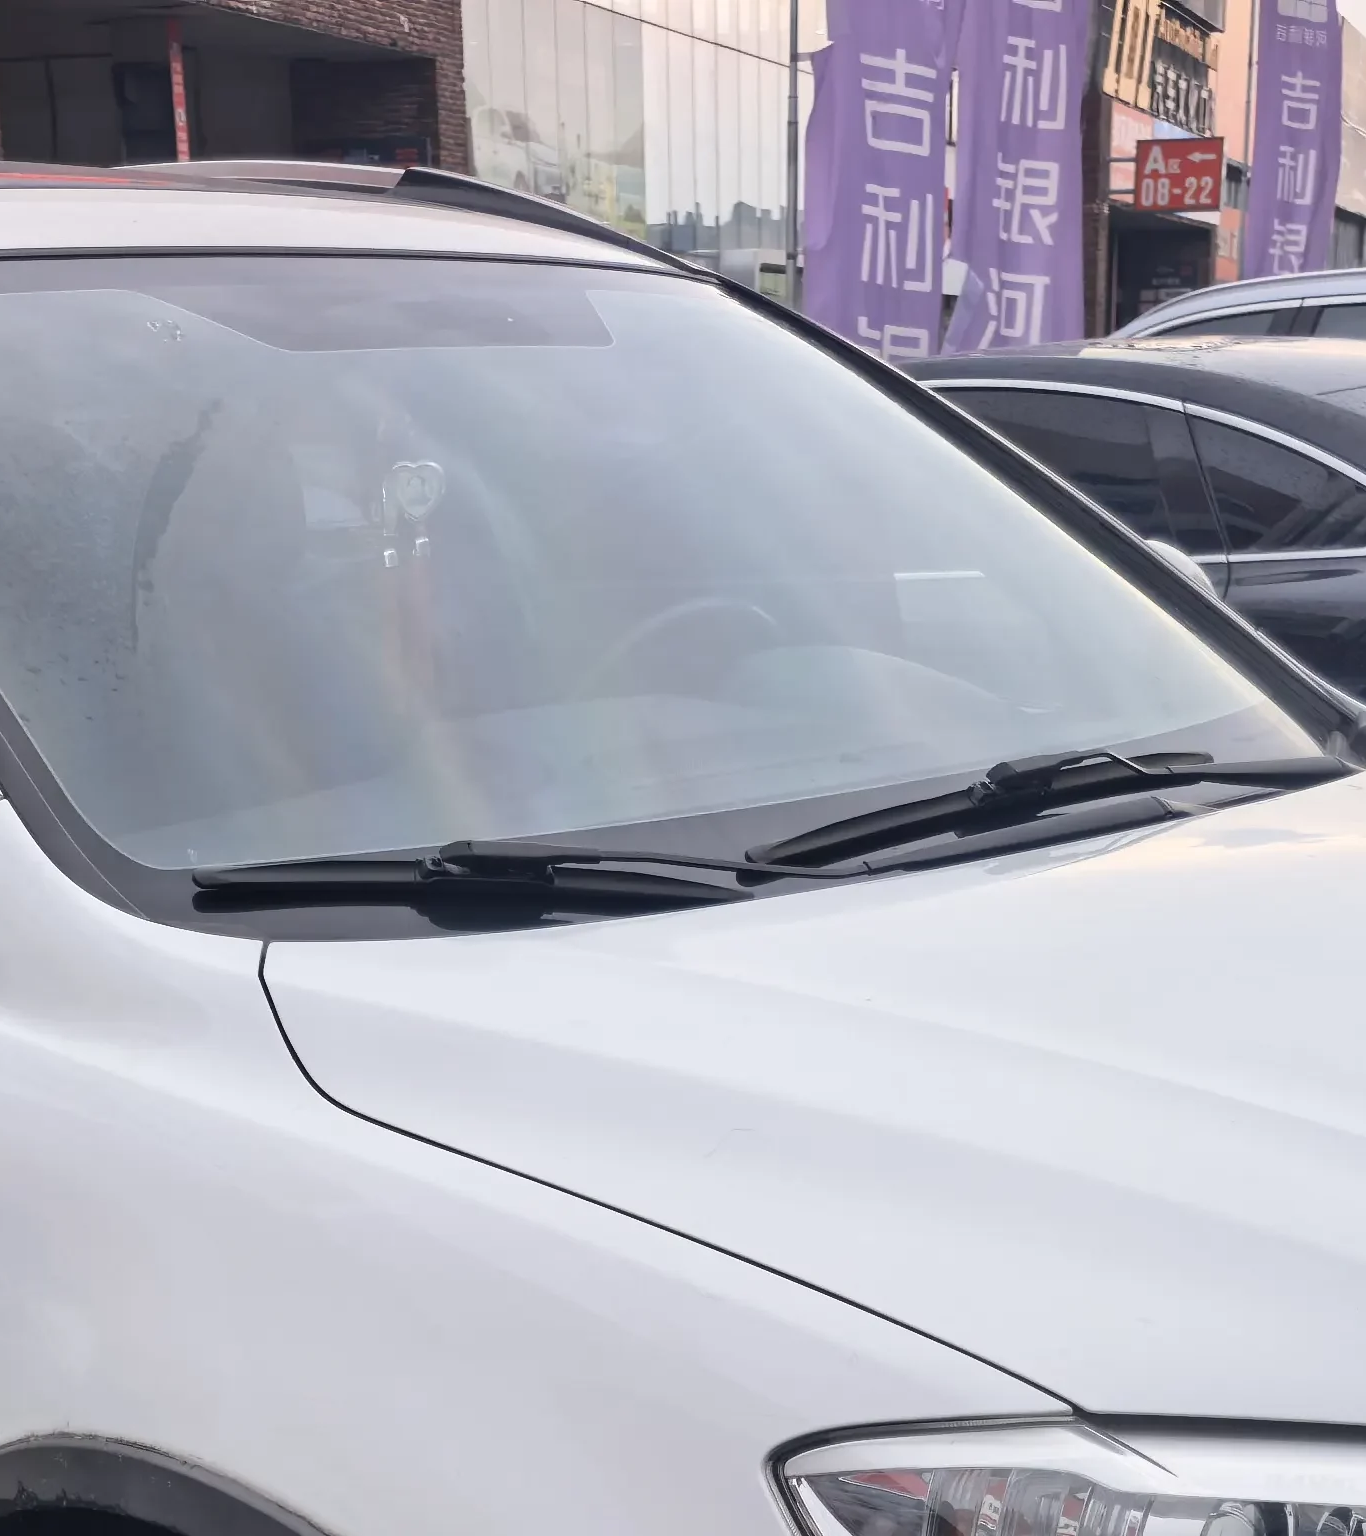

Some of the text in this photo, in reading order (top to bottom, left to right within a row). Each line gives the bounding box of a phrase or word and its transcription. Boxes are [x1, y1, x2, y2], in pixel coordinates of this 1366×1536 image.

[978, 0, 1067, 349] 利银河
[1141, 176, 1214, 206] 08-22
